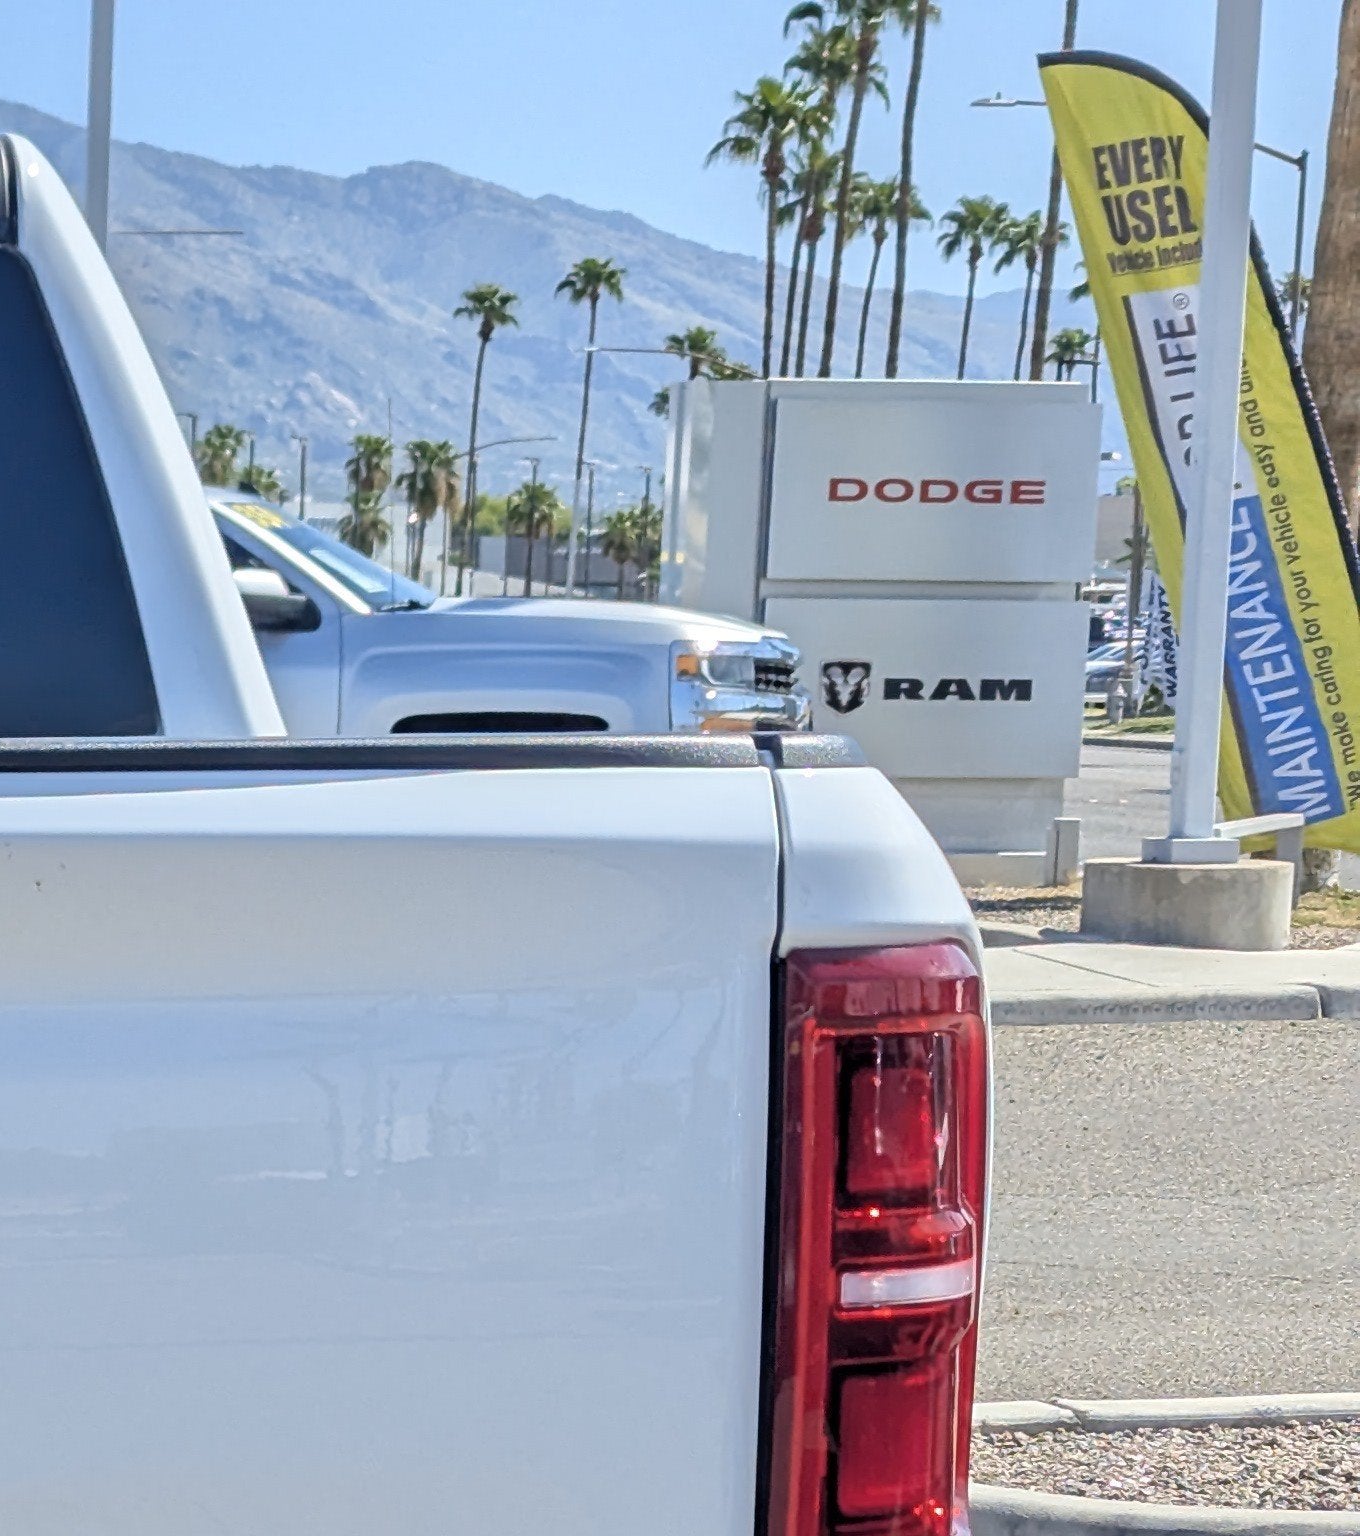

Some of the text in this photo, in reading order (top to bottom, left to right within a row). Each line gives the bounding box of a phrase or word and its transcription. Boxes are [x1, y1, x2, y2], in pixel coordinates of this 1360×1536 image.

[1091, 134, 1185, 190] EVERY
[1240, 397, 1265, 438] and
[1253, 443, 1280, 489] easy
[827, 478, 1046, 505] DODGE
[1268, 493, 1302, 566] vehicle
[1290, 570, 1320, 613] your
[1157, 584, 1178, 698] WARRANTY
[1303, 617, 1323, 644] for
[883, 677, 1033, 702] RAM
[1313, 646, 1343, 707] caring
[1332, 710, 1357, 766] make
